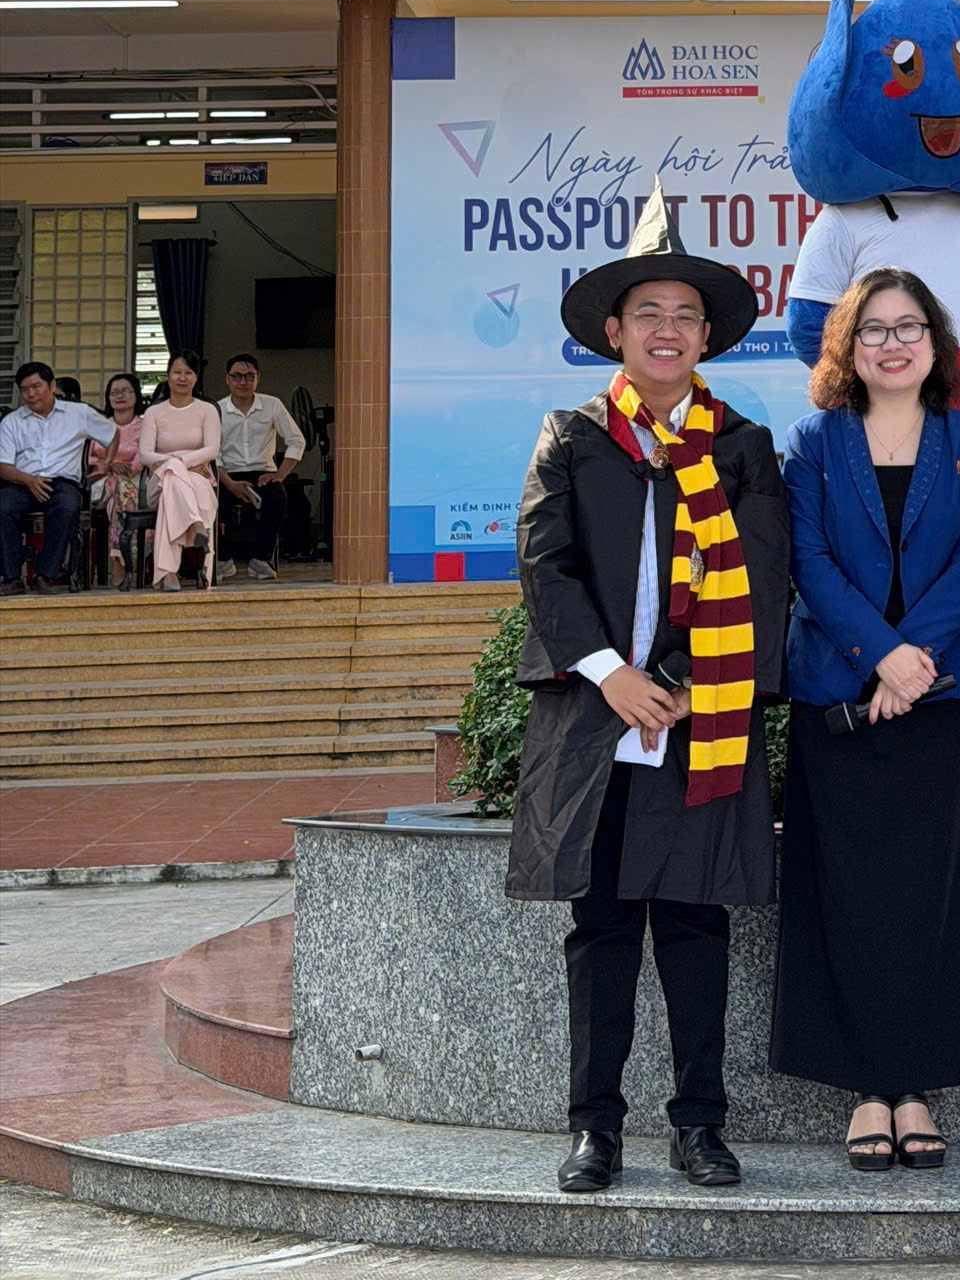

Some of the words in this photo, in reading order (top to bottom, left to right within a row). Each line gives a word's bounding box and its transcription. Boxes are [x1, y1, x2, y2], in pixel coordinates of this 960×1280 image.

[672, 64, 718, 80] HOA
[721, 64, 759, 80] SEN
[509, 125, 643, 208] Ngày
[657, 135, 724, 177] hội
[701, 194, 749, 248] TO
